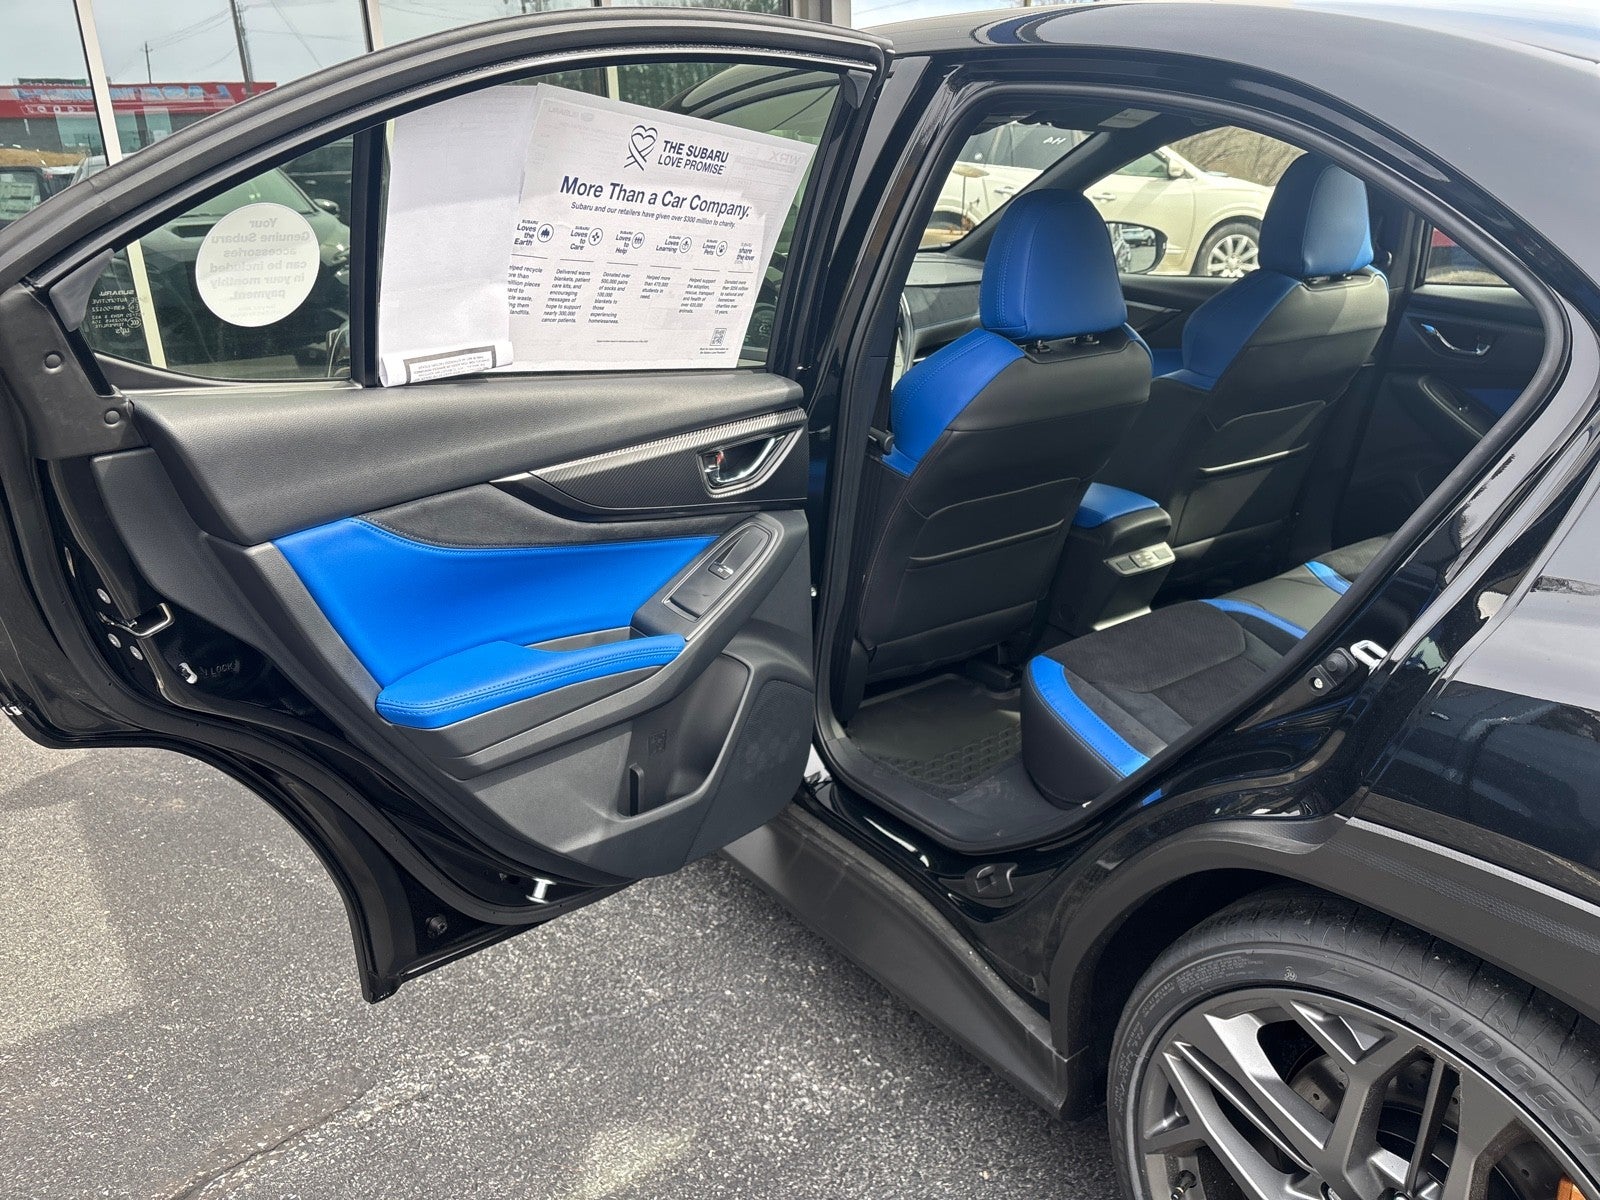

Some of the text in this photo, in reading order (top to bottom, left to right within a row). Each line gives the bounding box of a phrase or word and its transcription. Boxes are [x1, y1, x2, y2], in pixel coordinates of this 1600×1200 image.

[663, 140, 729, 162] THE SUBARU
[658, 154, 683, 168] LOVE
[684, 159, 724, 174] PROMISE
[560, 176, 750, 220] More Than a Car Company.
[571, 202, 593, 210] Subaru
[719, 220, 735, 229] charity.
[517, 224, 536, 232] Loves
[514, 238, 532, 246] Earth
[656, 246, 678, 254] Learning
